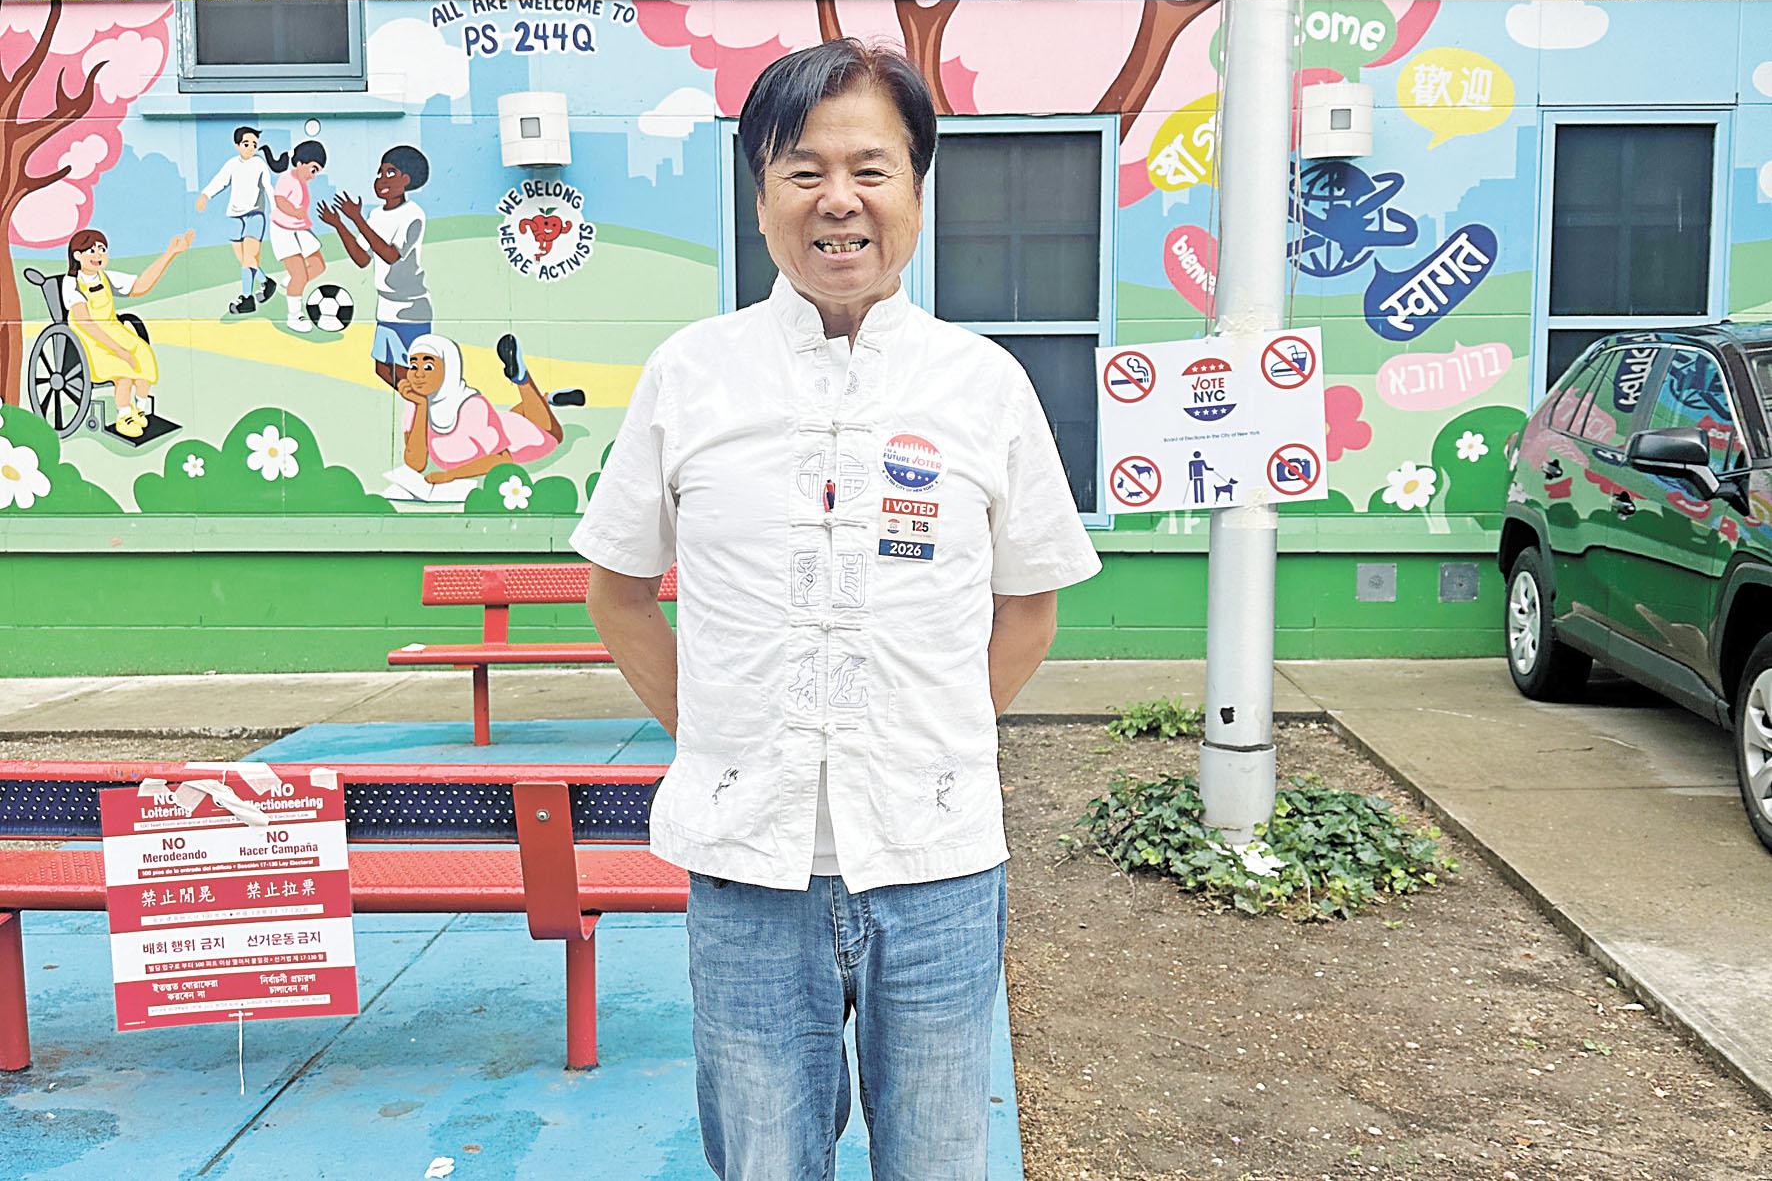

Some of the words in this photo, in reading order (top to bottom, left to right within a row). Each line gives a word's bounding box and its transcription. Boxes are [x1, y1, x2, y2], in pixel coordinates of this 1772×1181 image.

[432, 1, 463, 28] ALL
[517, 0, 602, 15] WELCOME
[612, 3, 636, 24] TO
[464, 24, 499, 57] PS
[514, 21, 595, 53] 244Q
[1410, 63, 1493, 112] 歡迎
[499, 190, 523, 216] WE
[523, 180, 582, 210] BELONG
[539, 223, 595, 280] ACTIVISTS
[1379, 232, 1490, 332] स्वागत
[1446, 347, 1501, 393] ברוך
[1192, 377, 1225, 390] VOTE
[1388, 362, 1444, 396] הבא
[1193, 390, 1225, 403] NYC
[883, 452, 910, 464] FUTURE
[911, 454, 943, 470] VOTER
[893, 501, 936, 516] VOTED
[912, 520, 929, 533] 125
[889, 542, 922, 557] 2026
[270, 783, 295, 797] NO
[153, 792, 178, 805] NO
[141, 805, 192, 819] Loitering
[162, 837, 186, 850] NO
[267, 831, 289, 843] NO
[143, 850, 207, 863] Merodeando
[240, 845, 268, 856] Hacer
[272, 842, 318, 855] Campaña
[247, 878, 316, 899] 禁止拉票
[142, 941, 167, 955] 배회
[171, 939, 195, 953] 행위
[200, 936, 225, 950] 금지
[247, 932, 295, 947] 선거운동
[297, 931, 321, 944] 금지
